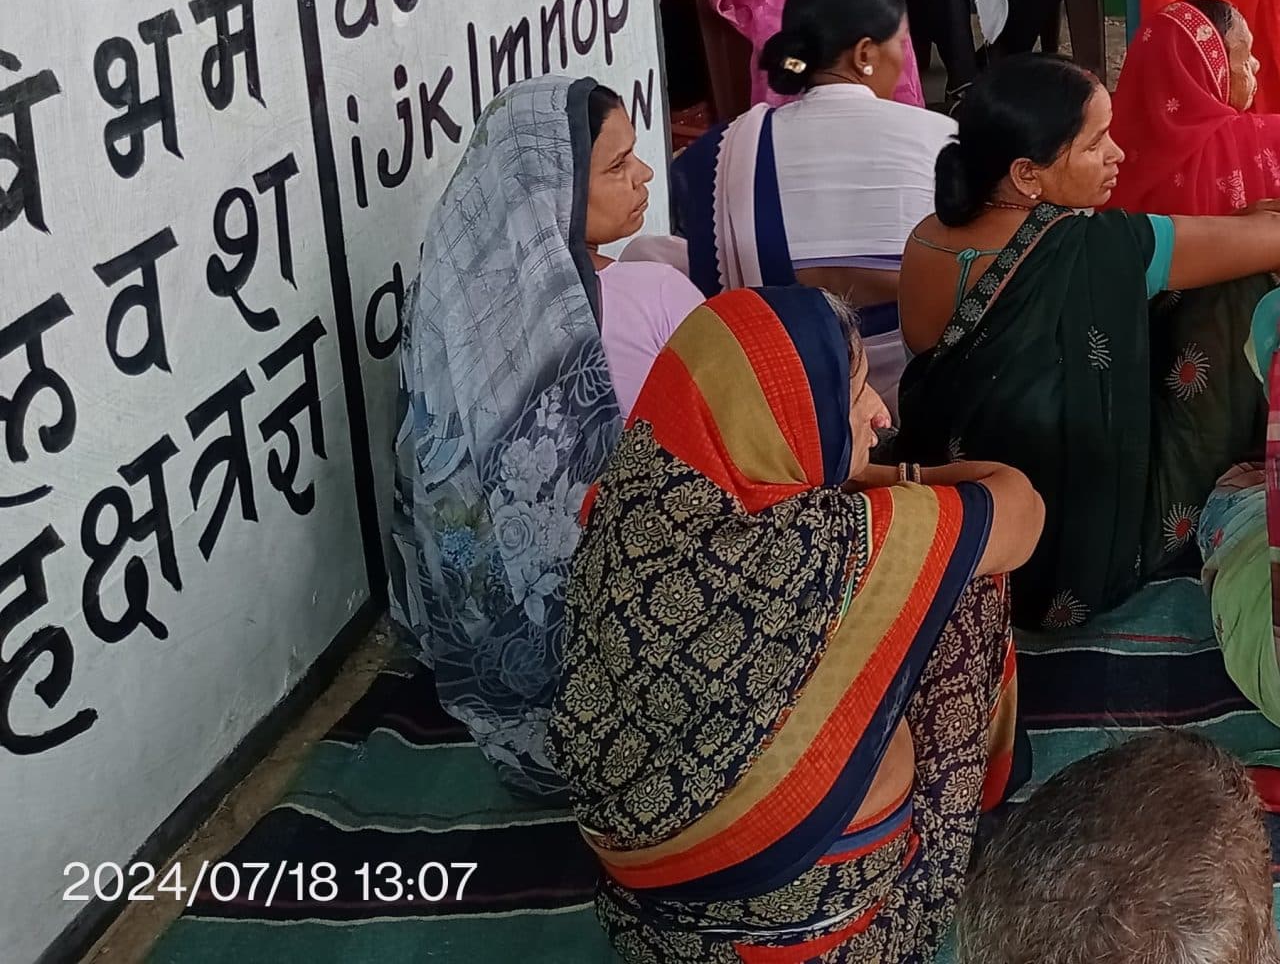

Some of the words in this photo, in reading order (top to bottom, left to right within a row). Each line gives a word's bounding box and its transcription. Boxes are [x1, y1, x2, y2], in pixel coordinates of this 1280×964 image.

[94, 8, 184, 179] भ
[93, 225, 179, 375] व
[206, 152, 300, 332] श
[185, 368, 256, 563] त्र
